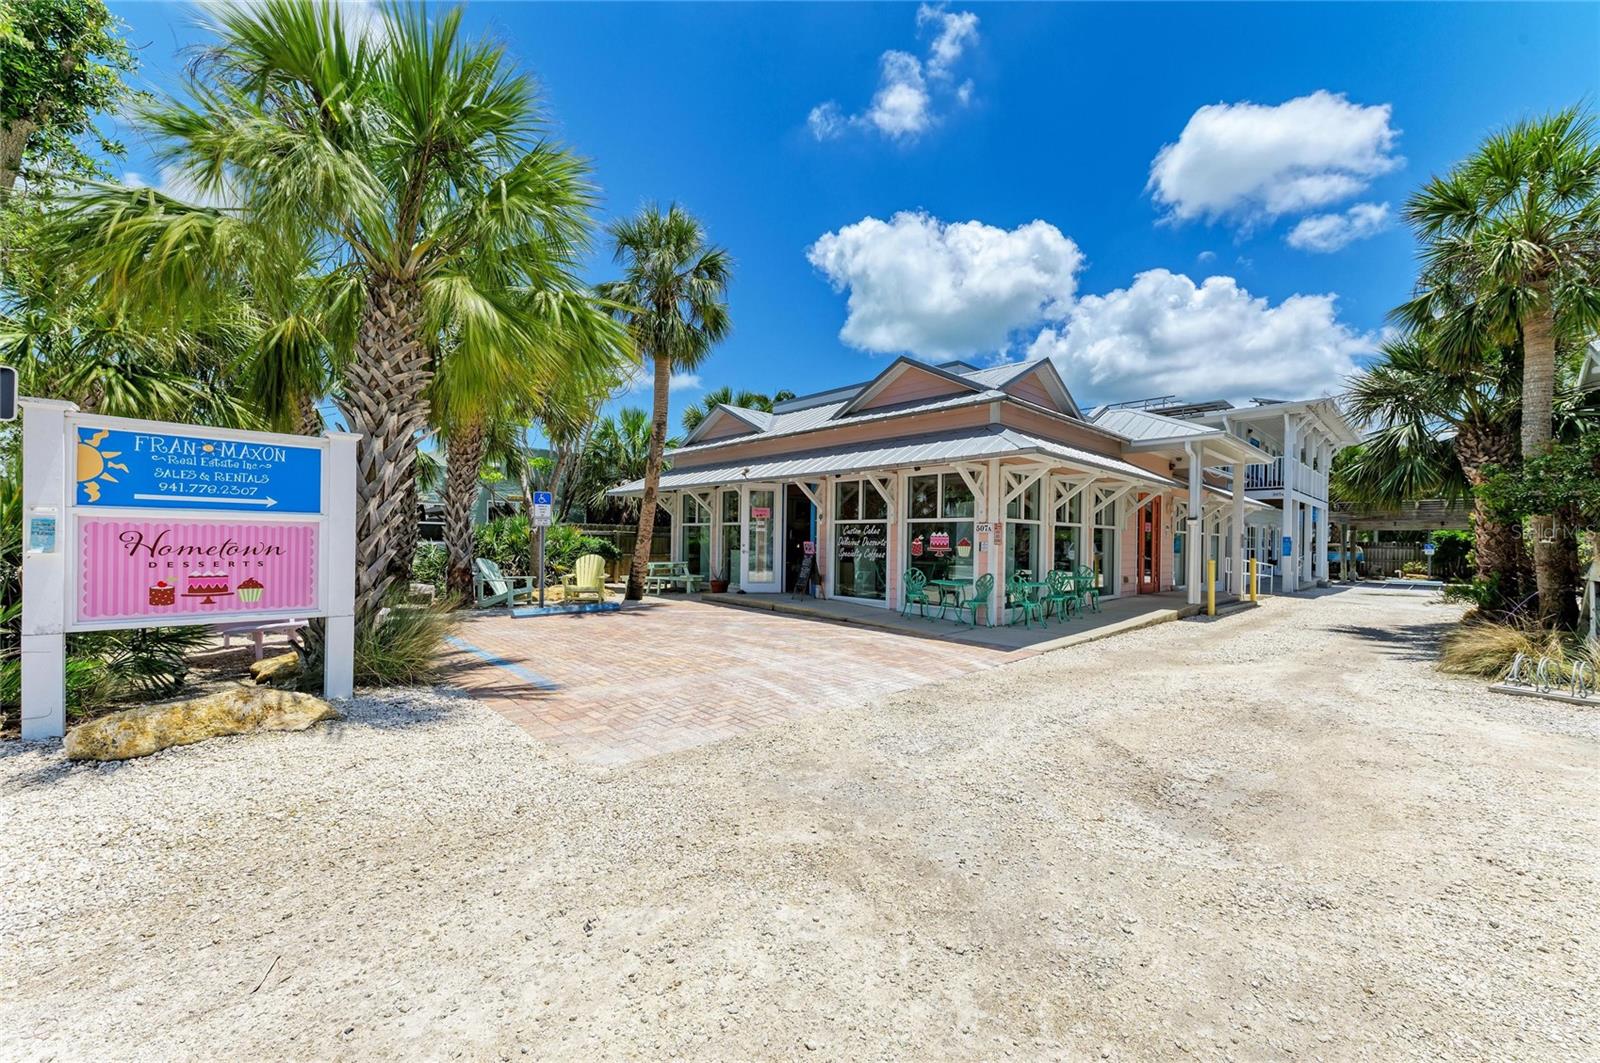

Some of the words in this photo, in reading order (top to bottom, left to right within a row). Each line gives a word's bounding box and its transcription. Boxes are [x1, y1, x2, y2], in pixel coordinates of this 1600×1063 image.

[135, 435, 196, 456] FRAN
[220, 442, 286, 463] MAXON
[168, 455, 197, 466] Real
[201, 457, 240, 469] Estate
[154, 467, 197, 479] SALES
[200, 472, 210, 482] &
[214, 471, 270, 484] RENTALS
[159, 482, 258, 496] 941.778.2307
[863, 524, 881, 535] Cakes
[119, 530, 286, 560] Hometown
[837, 536, 861, 546] Delicious
[861, 536, 887, 547] Desserts
[838, 547, 862, 561] Specialty
[863, 548, 886, 561] Coffees
[148, 561, 264, 569] DESSERTS
